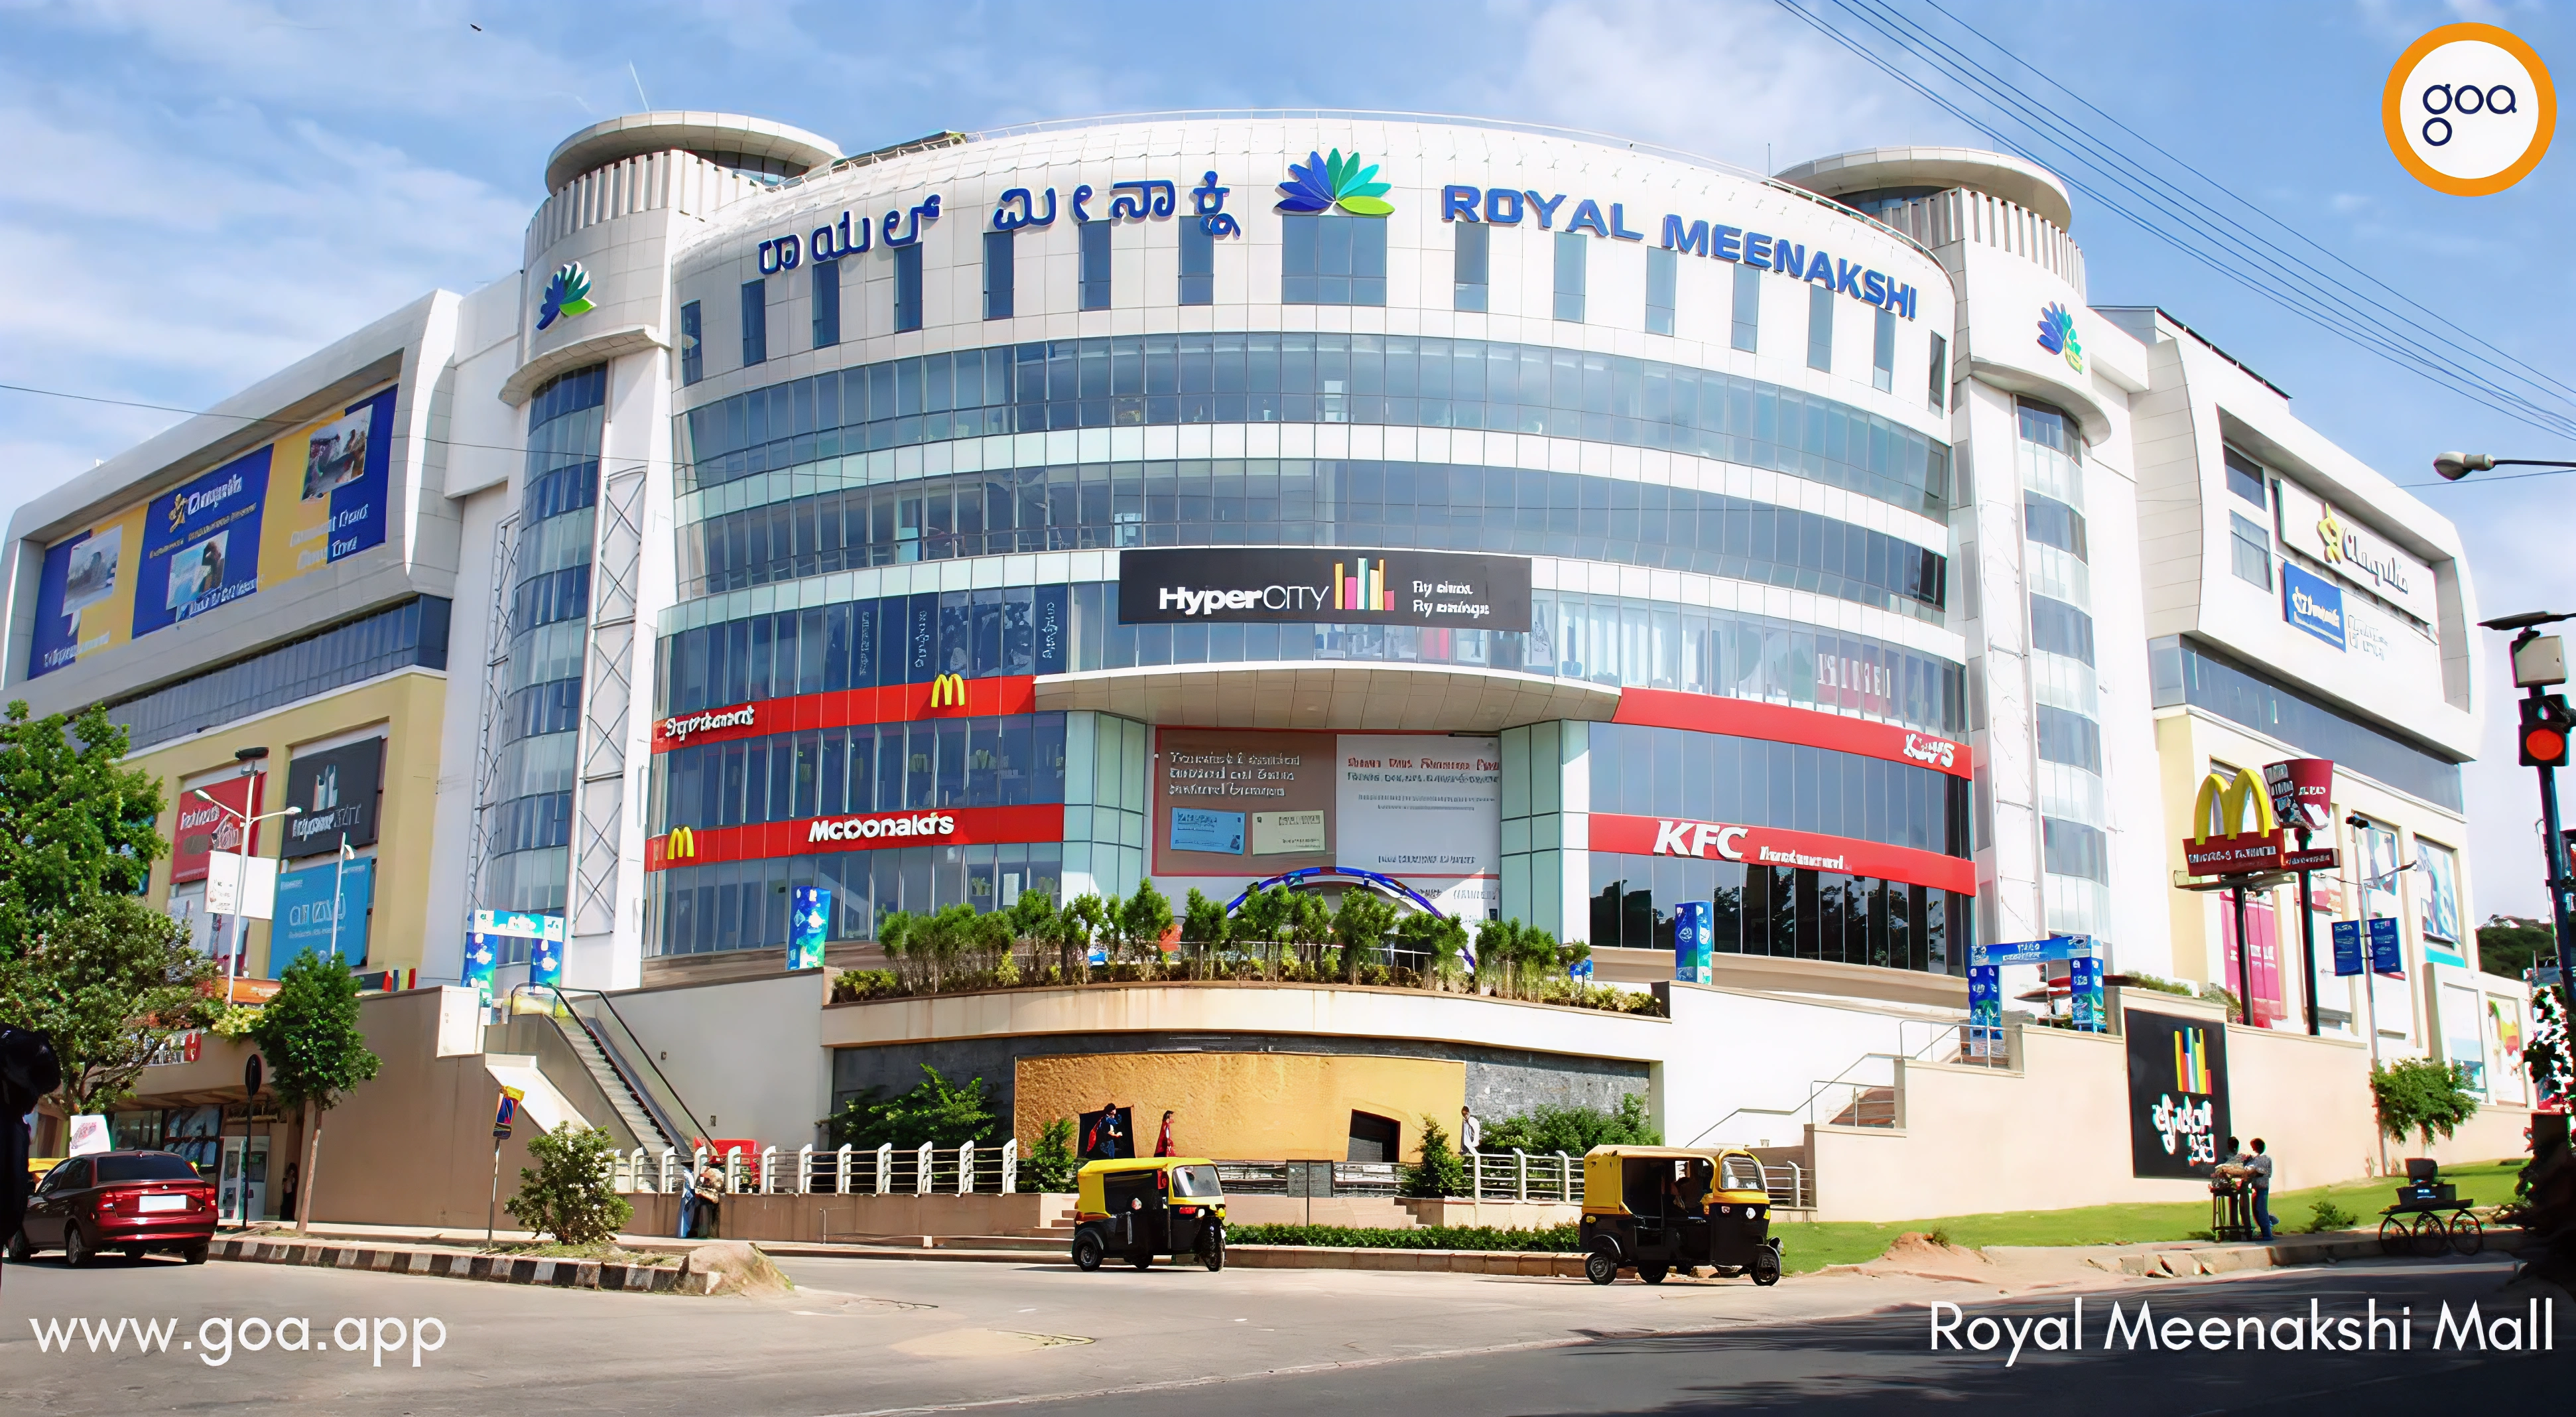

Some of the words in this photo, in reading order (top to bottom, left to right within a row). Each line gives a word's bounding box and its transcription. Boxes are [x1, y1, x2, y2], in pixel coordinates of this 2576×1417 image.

[1441, 184, 1644, 241] ROYAL
[1661, 214, 1917, 320] MEENAKSHI
[1159, 585, 1330, 615] HyperCITY
[808, 812, 955, 843] McDonald's
[1652, 819, 1749, 860] KFC
